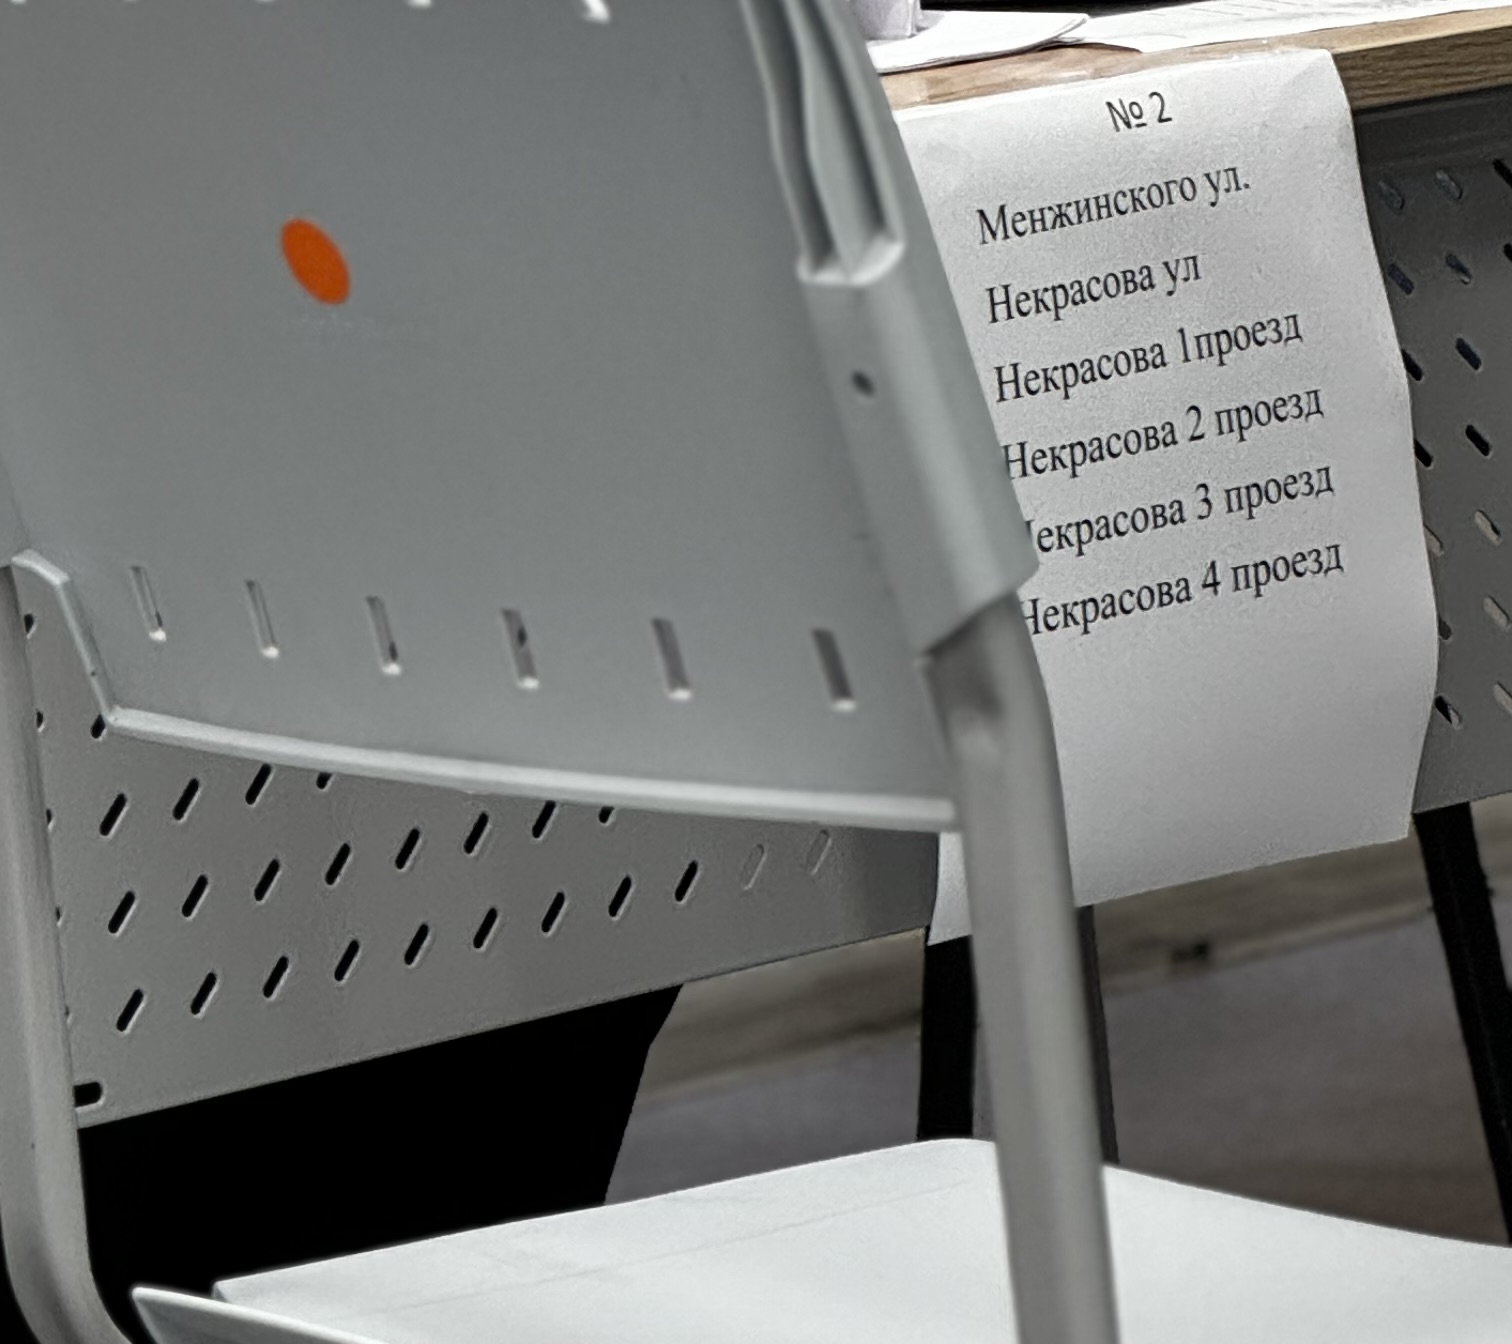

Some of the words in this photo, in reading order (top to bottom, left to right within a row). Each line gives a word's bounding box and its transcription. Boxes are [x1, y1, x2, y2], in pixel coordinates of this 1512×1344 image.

[976, 176, 1198, 245] Менжинского
[1203, 166, 1251, 208] ул.
[985, 264, 1156, 324] Некрасова
[1162, 255, 1202, 297] ул
[994, 342, 1168, 403] Некрасова
[1003, 421, 1178, 479] Некрасова
[1186, 405, 1206, 443] 2
[1215, 388, 1325, 443] проезд
[1026, 499, 1187, 557] екрасова
[1195, 483, 1213, 520] 3
[1224, 466, 1335, 520] проезд
[1201, 560, 1222, 597] 4
[1231, 543, 1345, 599] проезд
